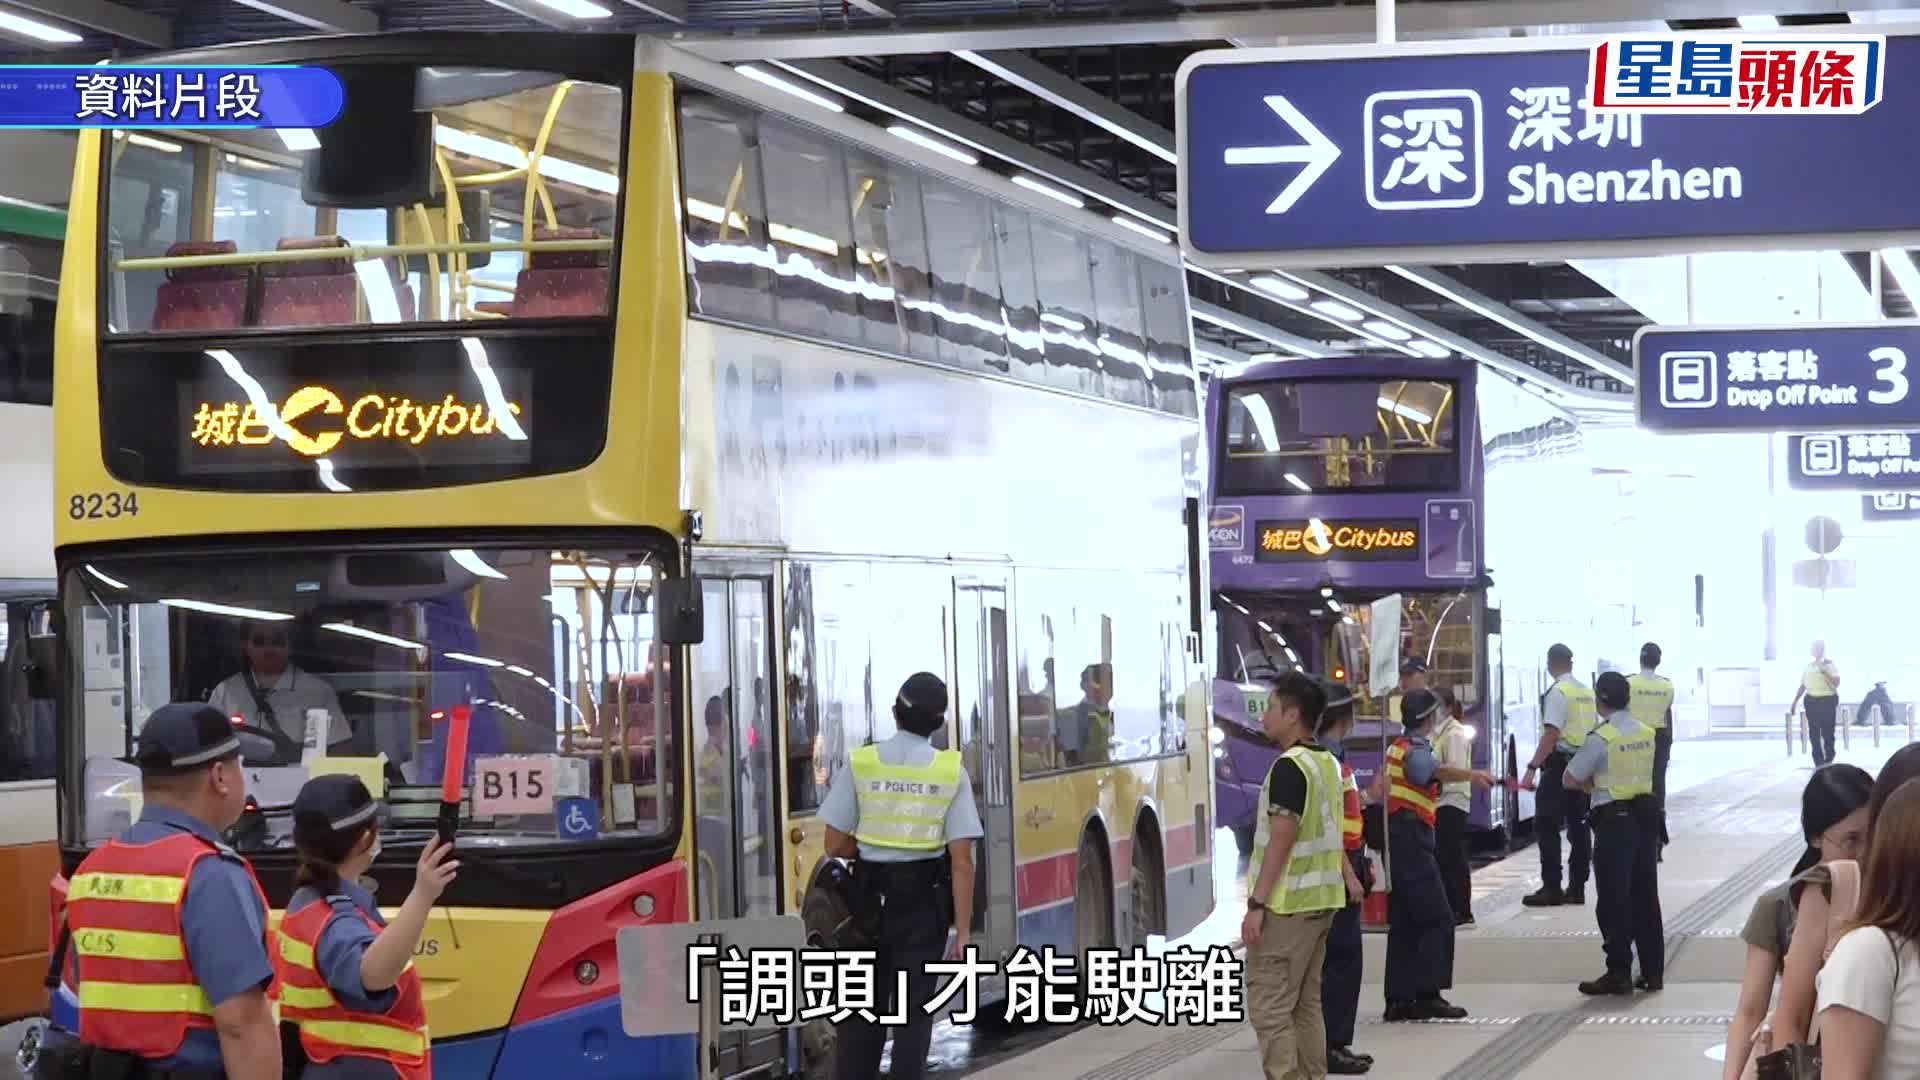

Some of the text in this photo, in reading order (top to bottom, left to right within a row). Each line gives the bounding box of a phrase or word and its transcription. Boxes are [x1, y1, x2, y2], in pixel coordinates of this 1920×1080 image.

[1379, 108, 1468, 194] 深
[1507, 158, 1743, 206] Shenzhen
[1727, 348, 1818, 382] 落客點
[1868, 346, 1909, 404] 3
[1727, 384, 1857, 411] Drop Off Point
[192, 403, 280, 446] 城巴
[70, 491, 139, 520] 8234
[1262, 529, 1302, 550] 城巴
[1334, 527, 1415, 550] Citybus
[483, 770, 544, 799] B15
[885, 782, 924, 795] POLICE
